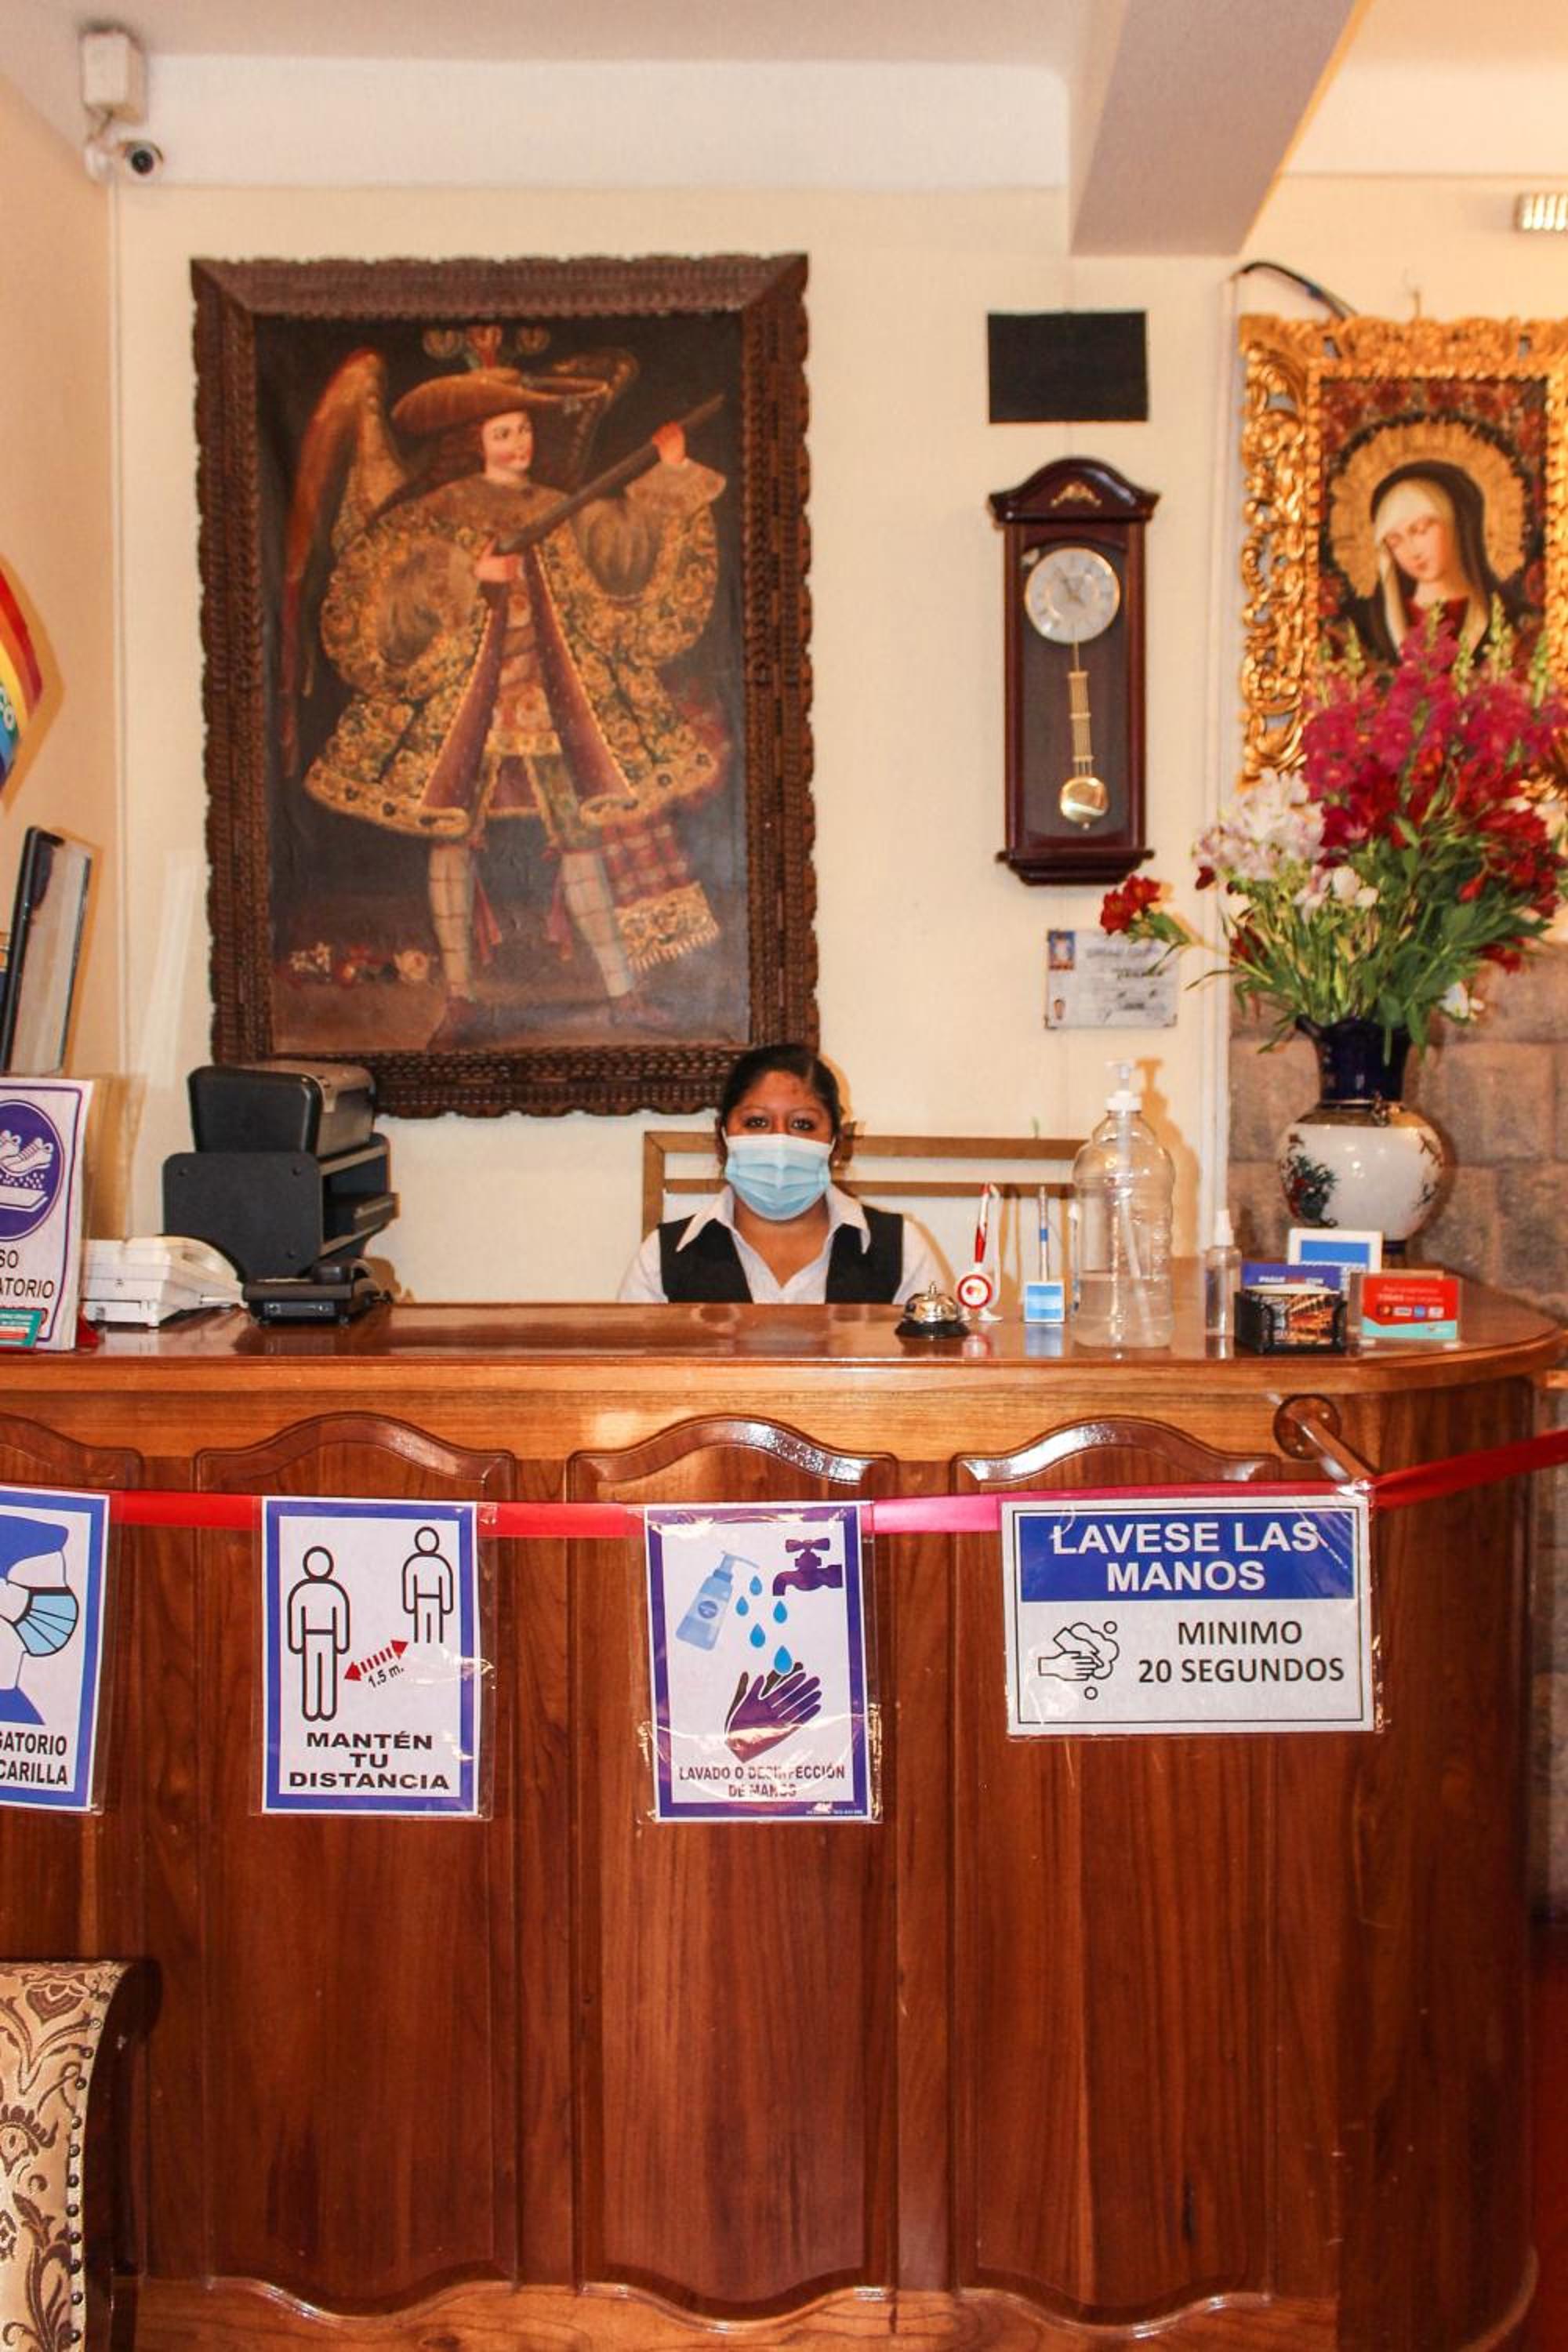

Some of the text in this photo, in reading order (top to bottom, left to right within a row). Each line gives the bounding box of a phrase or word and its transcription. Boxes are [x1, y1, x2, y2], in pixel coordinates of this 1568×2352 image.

[1053, 1521, 1318, 1555] LAVESE LAS
[1108, 1561, 1266, 1592] MANOS
[1178, 1621, 1302, 1645] MINIMO
[368, 1664, 404, 1687] 1.5 m.
[1138, 1657, 1345, 1682] 20 SEGUNDOS
[0, 1731, 67, 1756] ATORIO
[307, 1731, 432, 1749] MANTÉN
[0, 1759, 67, 1784] CARILLA
[350, 1753, 388, 1768] TU
[289, 1772, 449, 1789] DISTANCIA
[679, 1766, 730, 1780] LAVADO
[735, 1766, 744, 1779] O
[728, 1784, 745, 1797] DE
